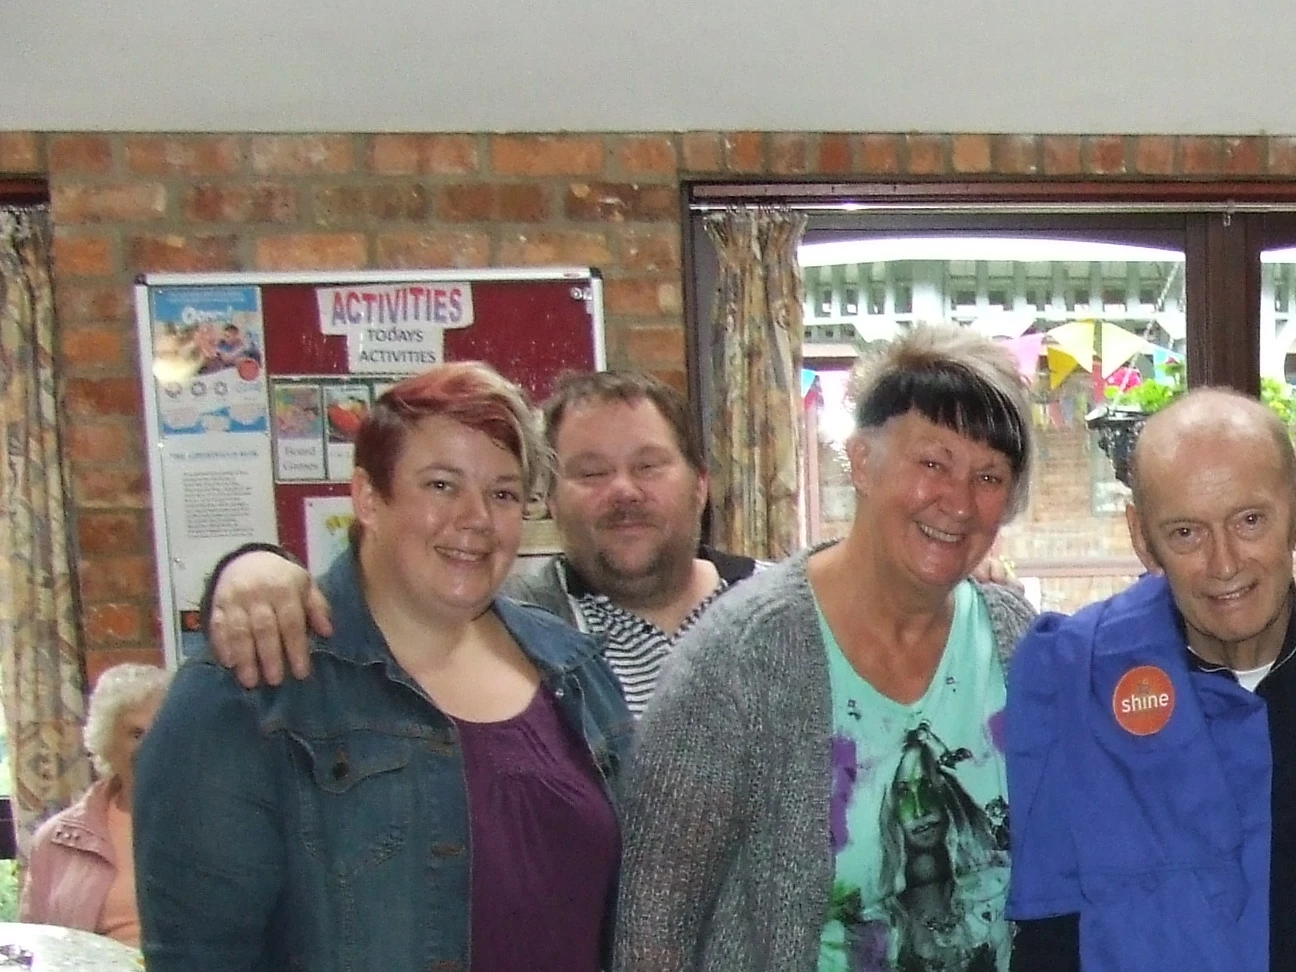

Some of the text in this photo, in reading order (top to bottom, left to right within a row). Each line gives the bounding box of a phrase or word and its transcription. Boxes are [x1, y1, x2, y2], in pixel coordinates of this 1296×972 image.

[332, 287, 463, 326] ACTIVITIES
[360, 350, 436, 364] ACTIVITIES
[1121, 693, 1169, 713] shine
